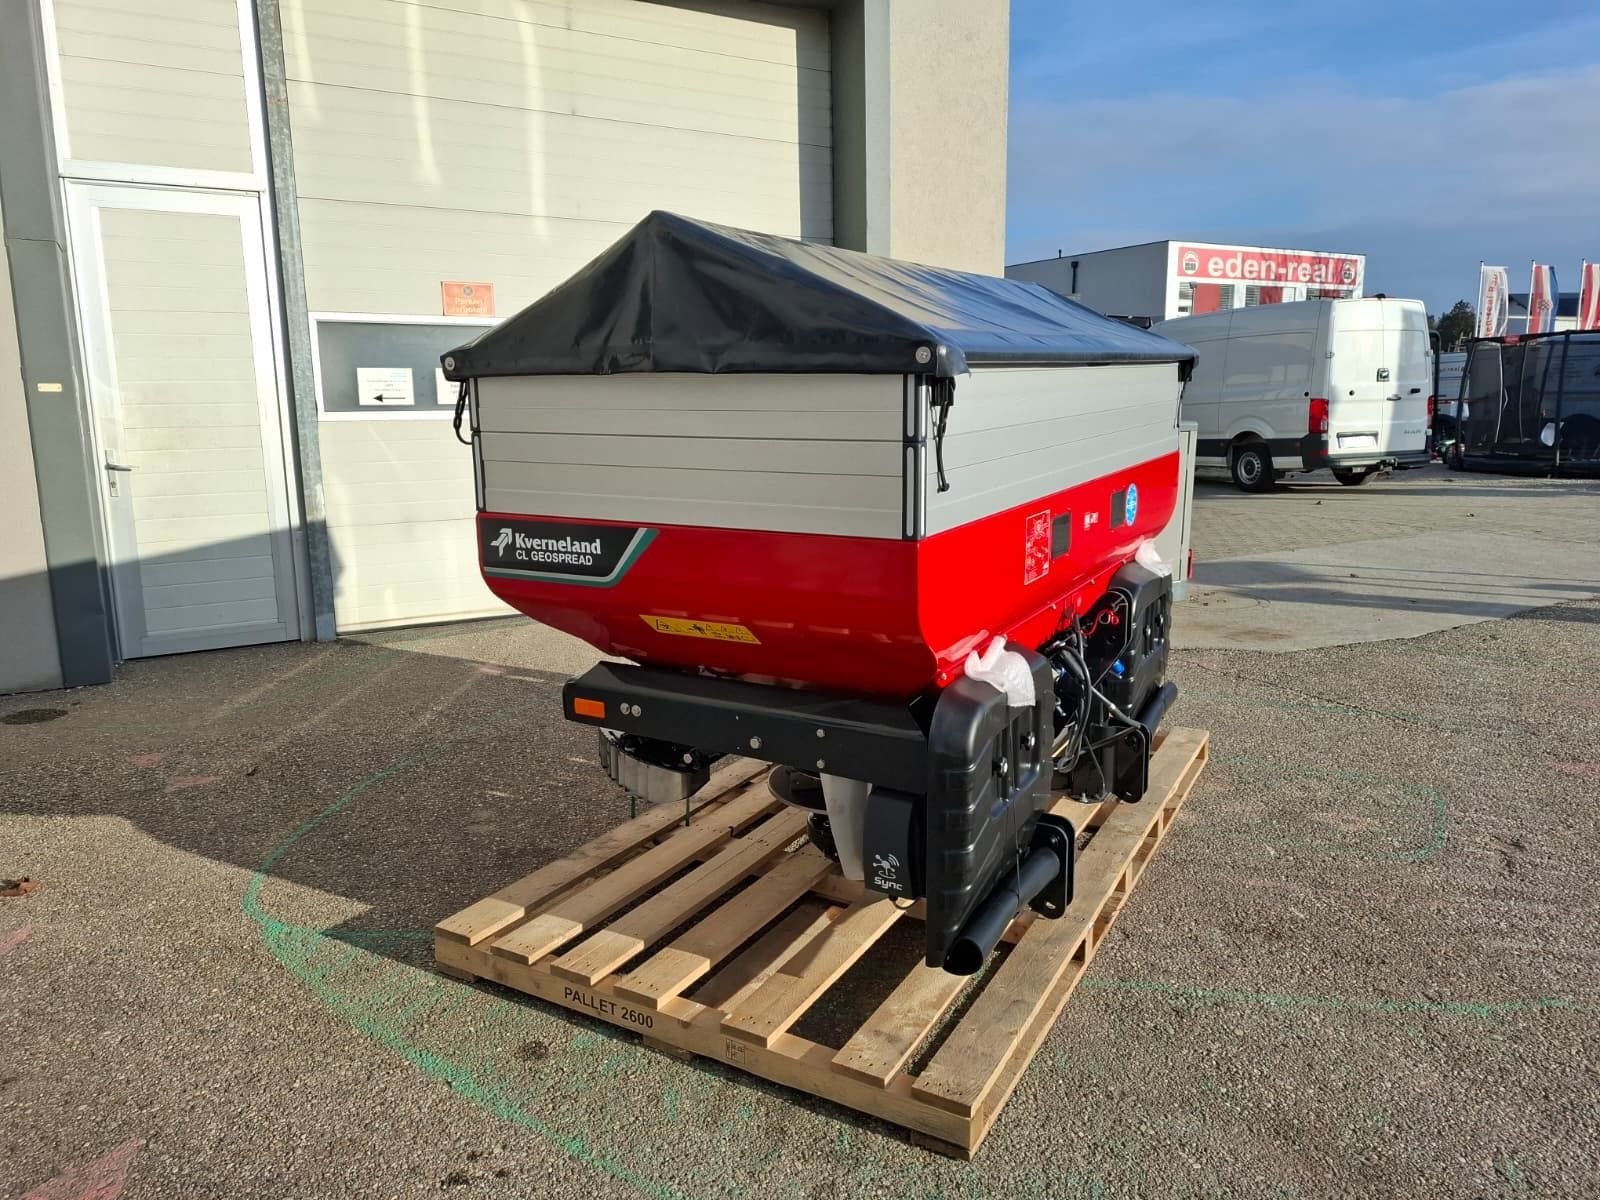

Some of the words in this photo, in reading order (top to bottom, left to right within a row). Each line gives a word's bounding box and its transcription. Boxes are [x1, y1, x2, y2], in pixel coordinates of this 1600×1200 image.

[1207, 253, 1334, 283] eden-real
[515, 533, 601, 554] Kverneland
[516, 550, 529, 560] CL
[531, 551, 593, 566] GEOSPREAD
[564, 987, 617, 1015] PALLET
[620, 1006, 653, 1029] 2600
